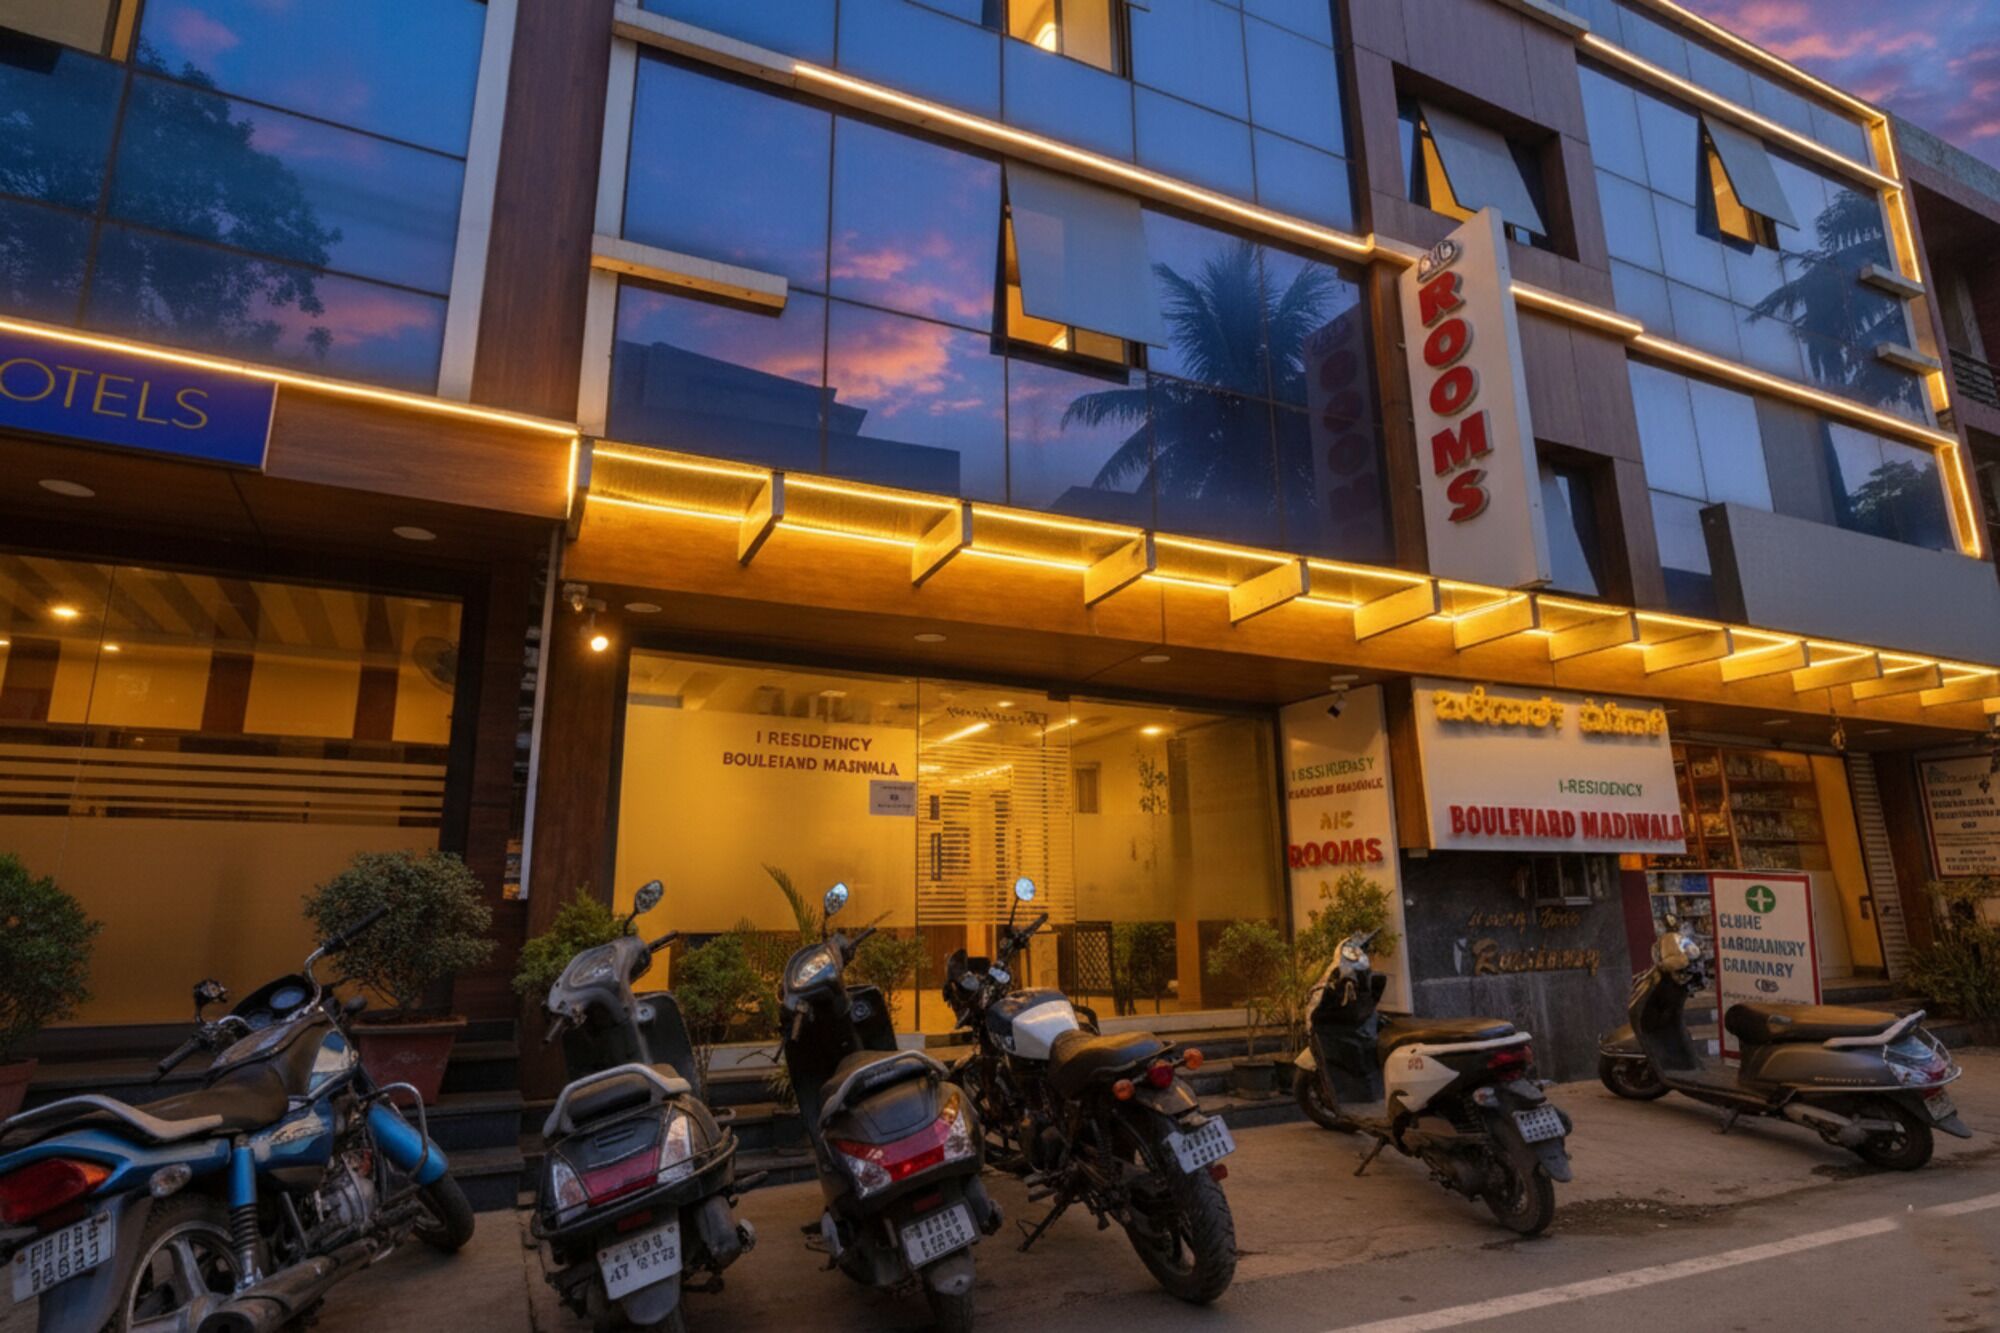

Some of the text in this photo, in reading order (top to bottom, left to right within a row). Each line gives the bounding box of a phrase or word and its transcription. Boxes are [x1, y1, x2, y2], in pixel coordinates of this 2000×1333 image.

[1418, 271, 1492, 522] ROOMS
[1450, 805, 1685, 841] BOULEVARD MADIWALA
[1288, 838, 1384, 869] ROOMS
